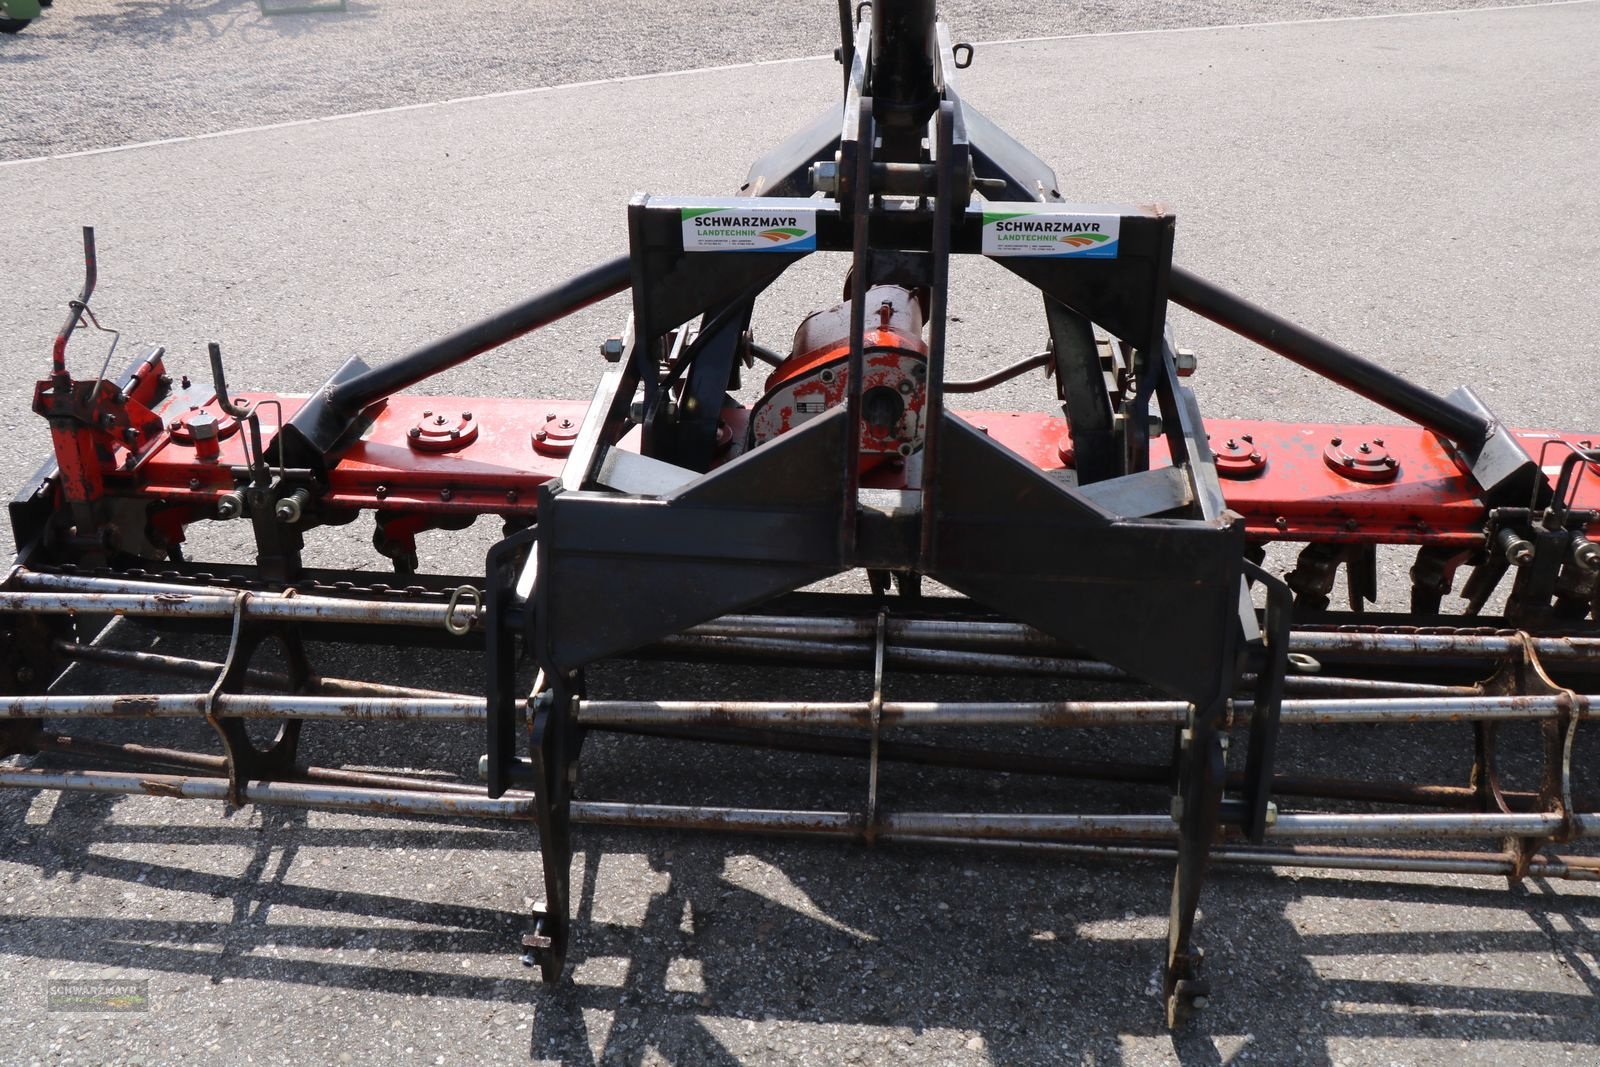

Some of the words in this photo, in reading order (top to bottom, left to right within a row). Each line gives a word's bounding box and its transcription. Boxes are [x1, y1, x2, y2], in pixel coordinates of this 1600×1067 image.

[695, 217, 797, 227] SCHWARZMAYR
[996, 221, 1101, 232] SCHWARZMAYR
[697, 229, 757, 237] LANDTECHNIK
[997, 234, 1058, 242] LANDTECHNIK
